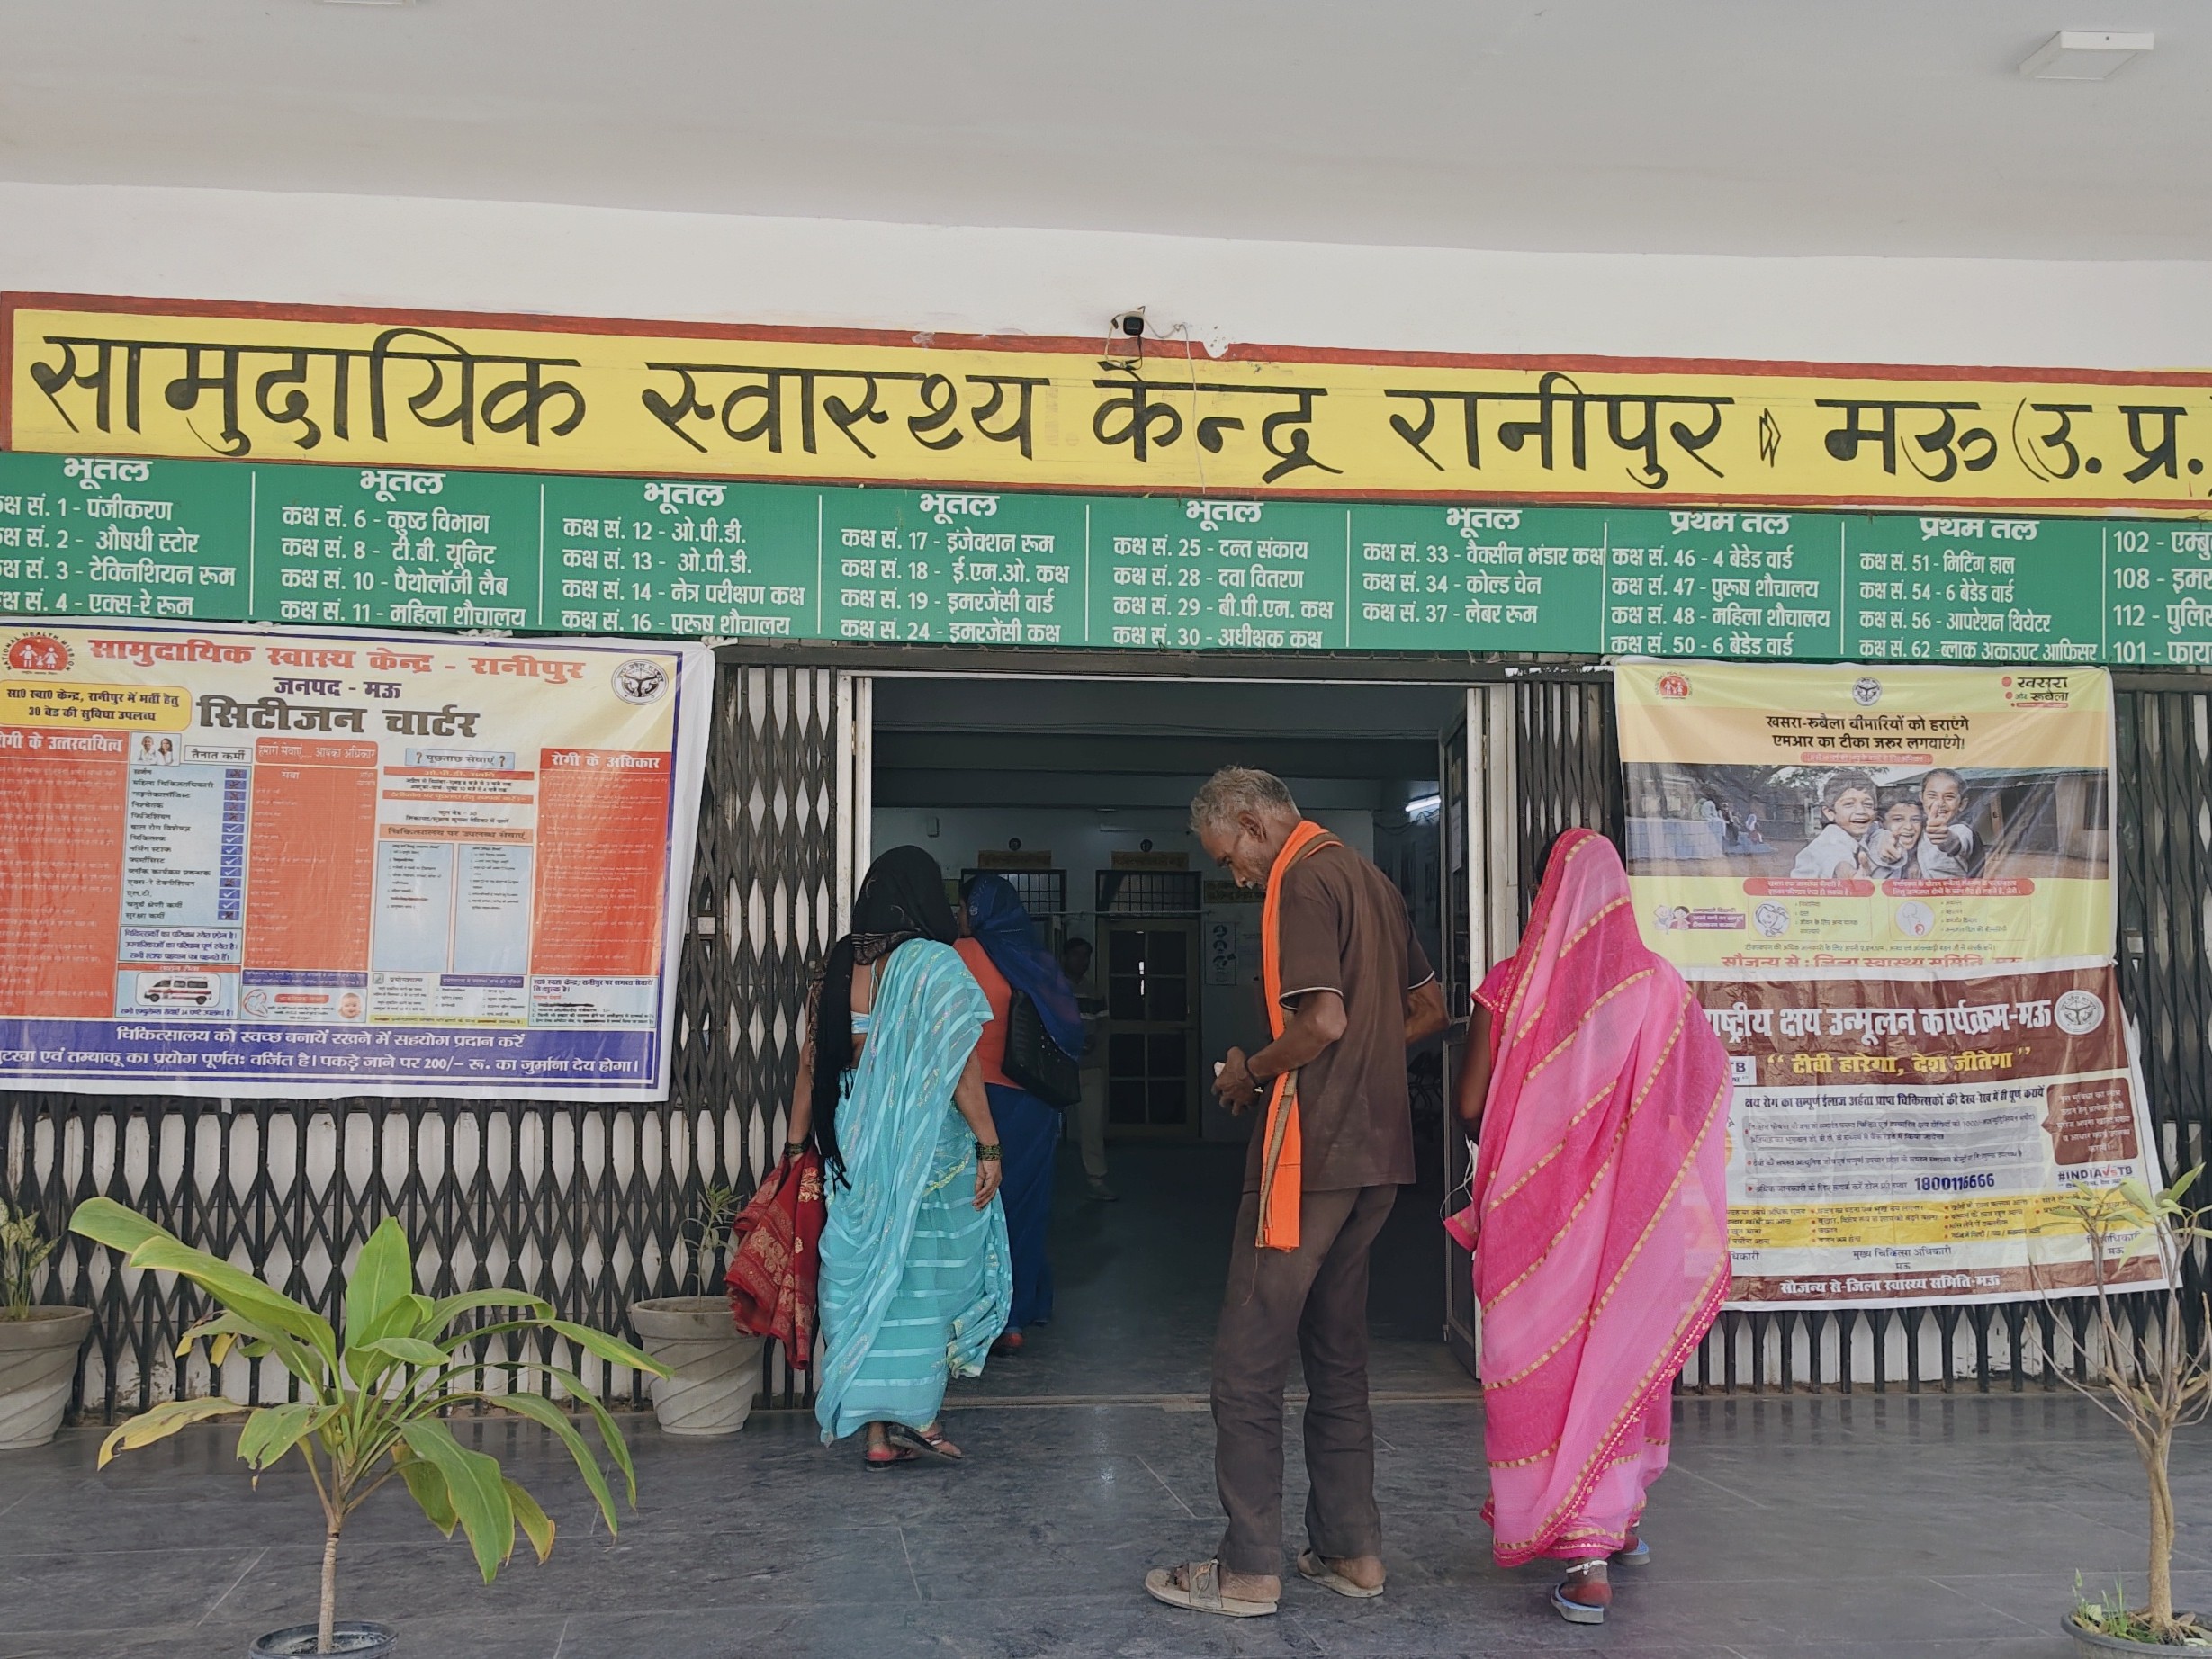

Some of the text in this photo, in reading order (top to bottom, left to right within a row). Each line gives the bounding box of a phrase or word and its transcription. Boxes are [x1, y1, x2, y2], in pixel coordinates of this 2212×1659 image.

[31, 328, 2212, 497] सामुदायिक स्वास्थ्य केन्द्र रानीपुर मऊ (उ.प्र.
[63, 457, 154, 490] भूतल
[360, 470, 447, 503] भूतल
[643, 482, 728, 515] भूतल
[27, 492, 50, 516] सं.
[57, 498, 67, 517] 1
[86, 492, 174, 521] पंजीकरण
[919, 493, 1001, 525] भूतल
[1185, 499, 1265, 532] भूतल
[282, 504, 490, 538] कक्ष सं. 6 कुष्ठ विभाग
[562, 516, 746, 543] कक्ष सं. 12 ओ.पी.डी.
[1445, 507, 1523, 539] भूतल
[1668, 511, 1793, 535] प्रथम तल
[1919, 516, 2040, 542] प्रथम तल
[1112, 534, 1309, 560] कक्ष सं. 25 दन्त संकाय
[2113, 530, 2150, 553] 102
[1611, 544, 1794, 569] कक्ष सं. 46 4 बेडेड वार्ड
[2113, 567, 2150, 590] 108
[2113, 604, 2145, 627] 112
[87, 638, 256, 668] सामुदायिक
[366, 647, 435, 674] केन्द्र
[468, 654, 587, 684] रानीपुर
[2113, 641, 2146, 664] 101
[88, 689, 125, 705] रानीपुर
[272, 677, 402, 699] जनपद मऊ
[195, 694, 481, 738] सिटीजन चार्टर
[1848, 713, 1906, 731] बीमारियों
[1909, 714, 1927, 731] को
[28, 733, 44, 750] के
[48, 734, 124, 753] उत्तरदायित्व
[1772, 734, 1813, 749] एमआर
[1818, 734, 1835, 749] का
[1839, 733, 1870, 749] टीका
[191, 748, 246, 762] तैनात कर्मी
[425, 753, 463, 765] पूछताछ
[552, 751, 661, 770] रोगी के अधिकार
[1721, 952, 1781, 968] सौजन्य
[1785, 954, 1801, 968] से
[116, 1025, 526, 1049] चिकित्सालय को स्वच्छ बनायें रखने में सहयोग प्रदान करें
[1779, 1008, 1823, 1036] क्षय
[1827, 1007, 1916, 1046] उन्मूलन
[40, 1047, 66, 1063] एवं
[67, 1051, 125, 1068] तम्बाकू
[126, 1052, 148, 1065] का
[153, 1050, 197, 1066] प्रयोग
[250, 1052, 293, 1068] वर्जित
[320, 1054, 360, 1072] पकड़े
[363, 1054, 396, 1069] जाने
[400, 1056, 420, 1070] पर
[496, 1058, 517, 1072] का
[520, 1055, 569, 1075] जुर्माना
[571, 1058, 596, 1072] देय
[1791, 1053, 1835, 1074] टीबी
[1911, 1052, 1947, 1073] देश
[1950, 1049, 2014, 1072] जीतेगा
[1763, 1095, 1778, 1107] रोग
[1781, 1097, 1794, 1107] का
[1914, 1172, 1995, 1191] 1800116666
[1853, 1245, 1952, 1260] मुख्य चिकित्सा अधिकारी
[1780, 1278, 1826, 1295] सौजन्य
